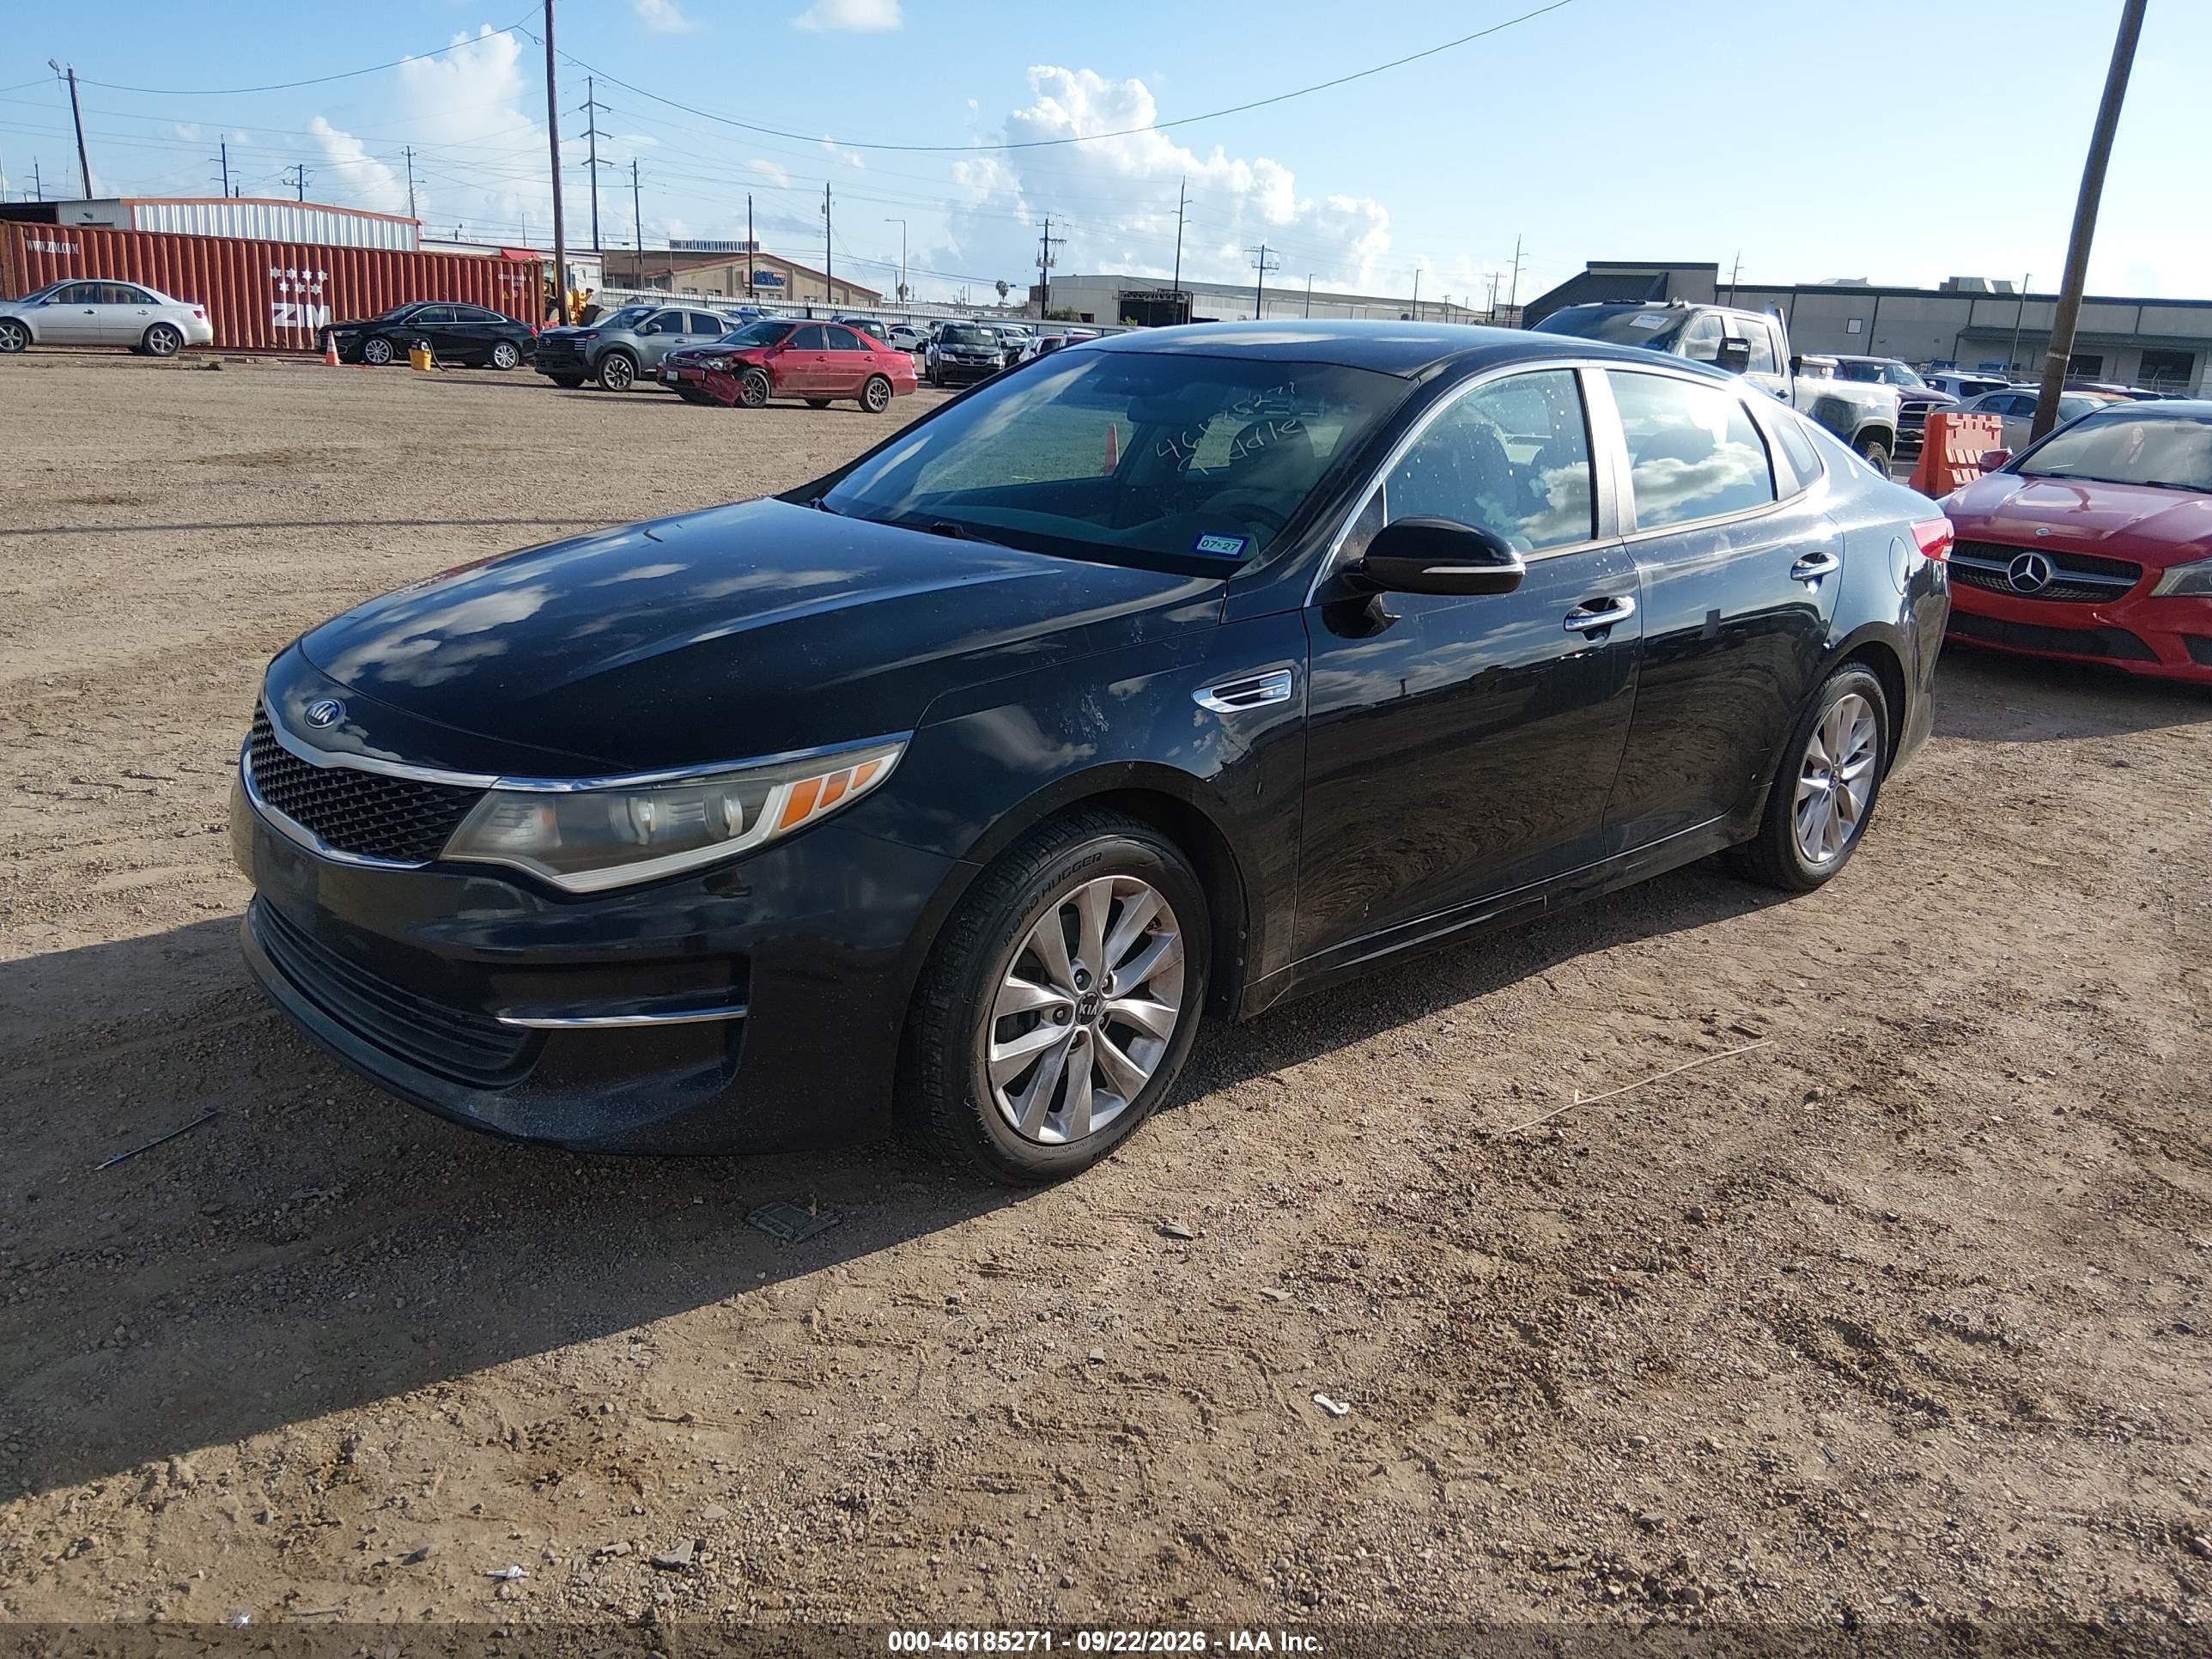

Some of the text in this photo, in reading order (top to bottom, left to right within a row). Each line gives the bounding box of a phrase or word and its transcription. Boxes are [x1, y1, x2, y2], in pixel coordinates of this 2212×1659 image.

[26, 240, 79, 255] WWW.ZIM.COM
[271, 302, 331, 328] ZIM
[1041, 852, 1103, 898] HUGGER
[1079, 1003, 1097, 1016] KIA
